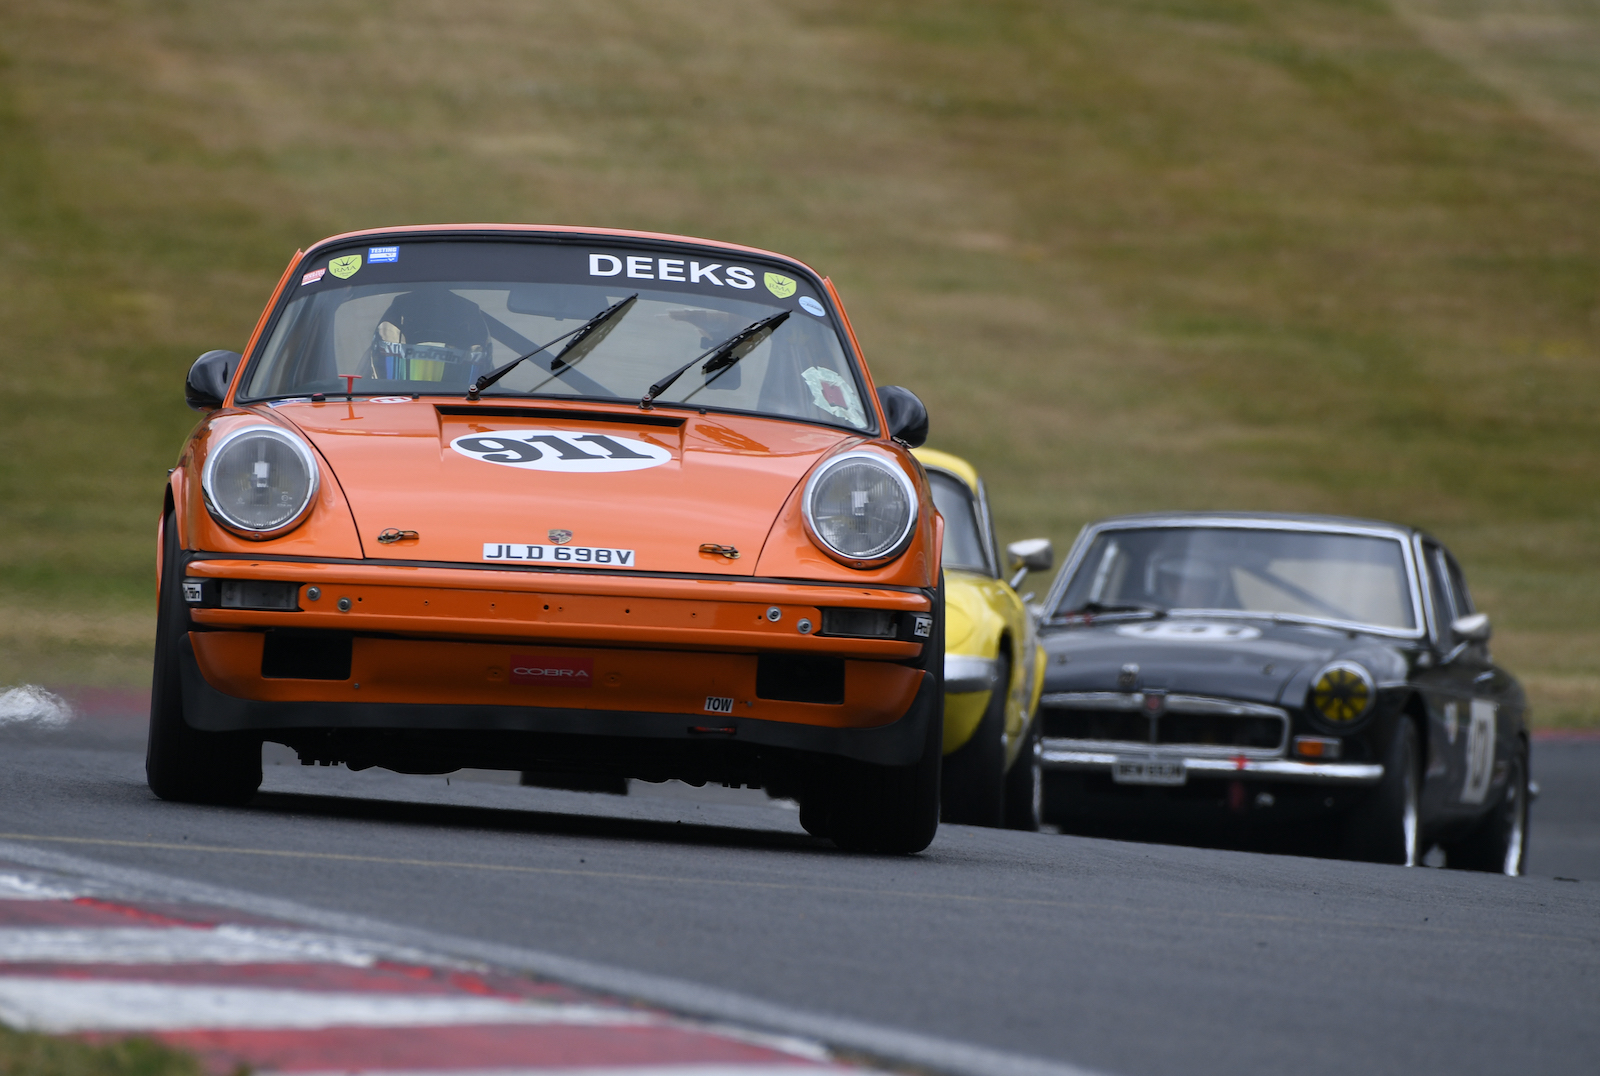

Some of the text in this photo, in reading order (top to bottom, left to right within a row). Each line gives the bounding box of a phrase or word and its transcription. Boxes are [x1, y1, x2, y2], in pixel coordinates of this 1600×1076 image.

[333, 265, 357, 274] RMA
[588, 253, 756, 290] DEEKS
[769, 283, 792, 294] RMA
[456, 434, 656, 463] 911
[486, 545, 631, 565] JLD 698V
[513, 667, 589, 678] COBRA
[706, 697, 732, 711] TOW
